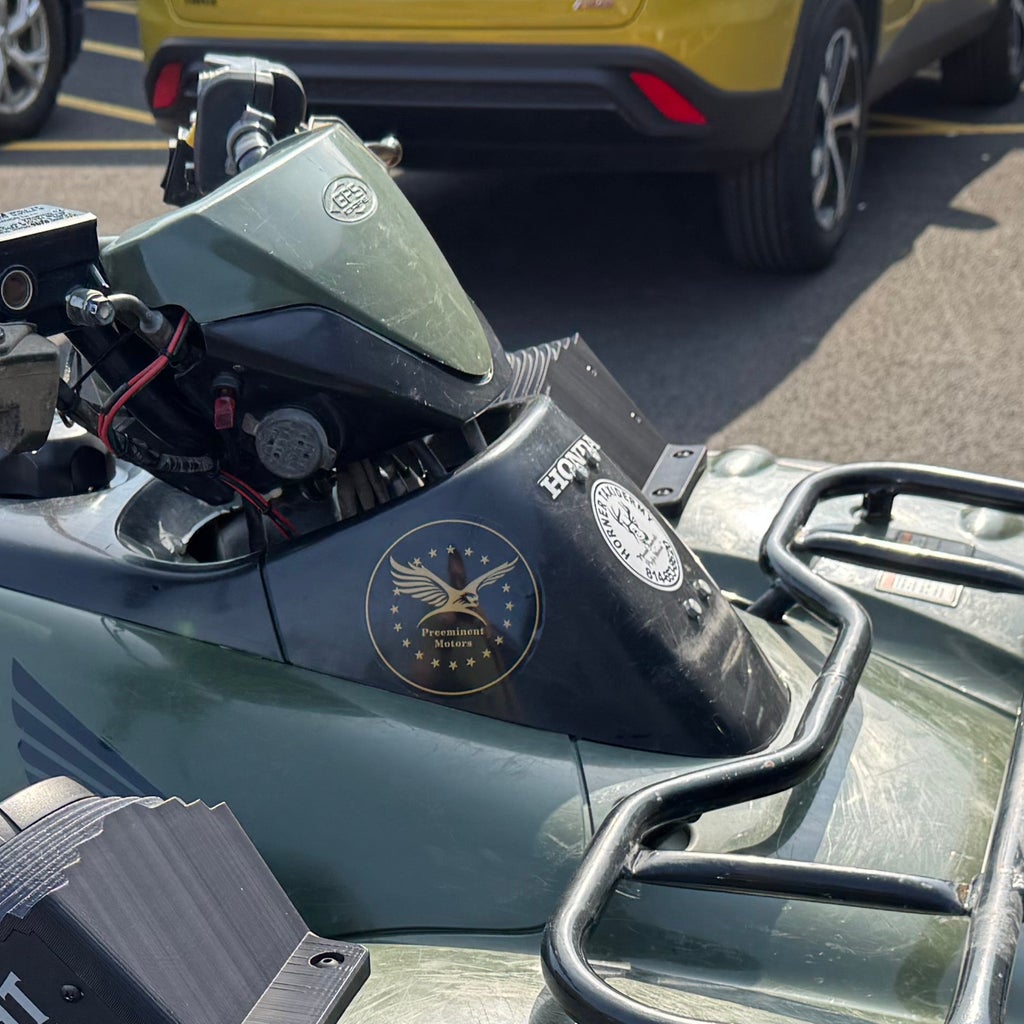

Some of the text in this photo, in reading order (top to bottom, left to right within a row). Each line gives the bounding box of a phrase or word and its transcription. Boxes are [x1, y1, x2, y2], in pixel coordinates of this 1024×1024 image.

[598, 485, 653, 522] TAXIDERMY
[596, 500, 631, 561] HORNER
[421, 626, 485, 637] Preeminent
[434, 638, 473, 649] Motors
